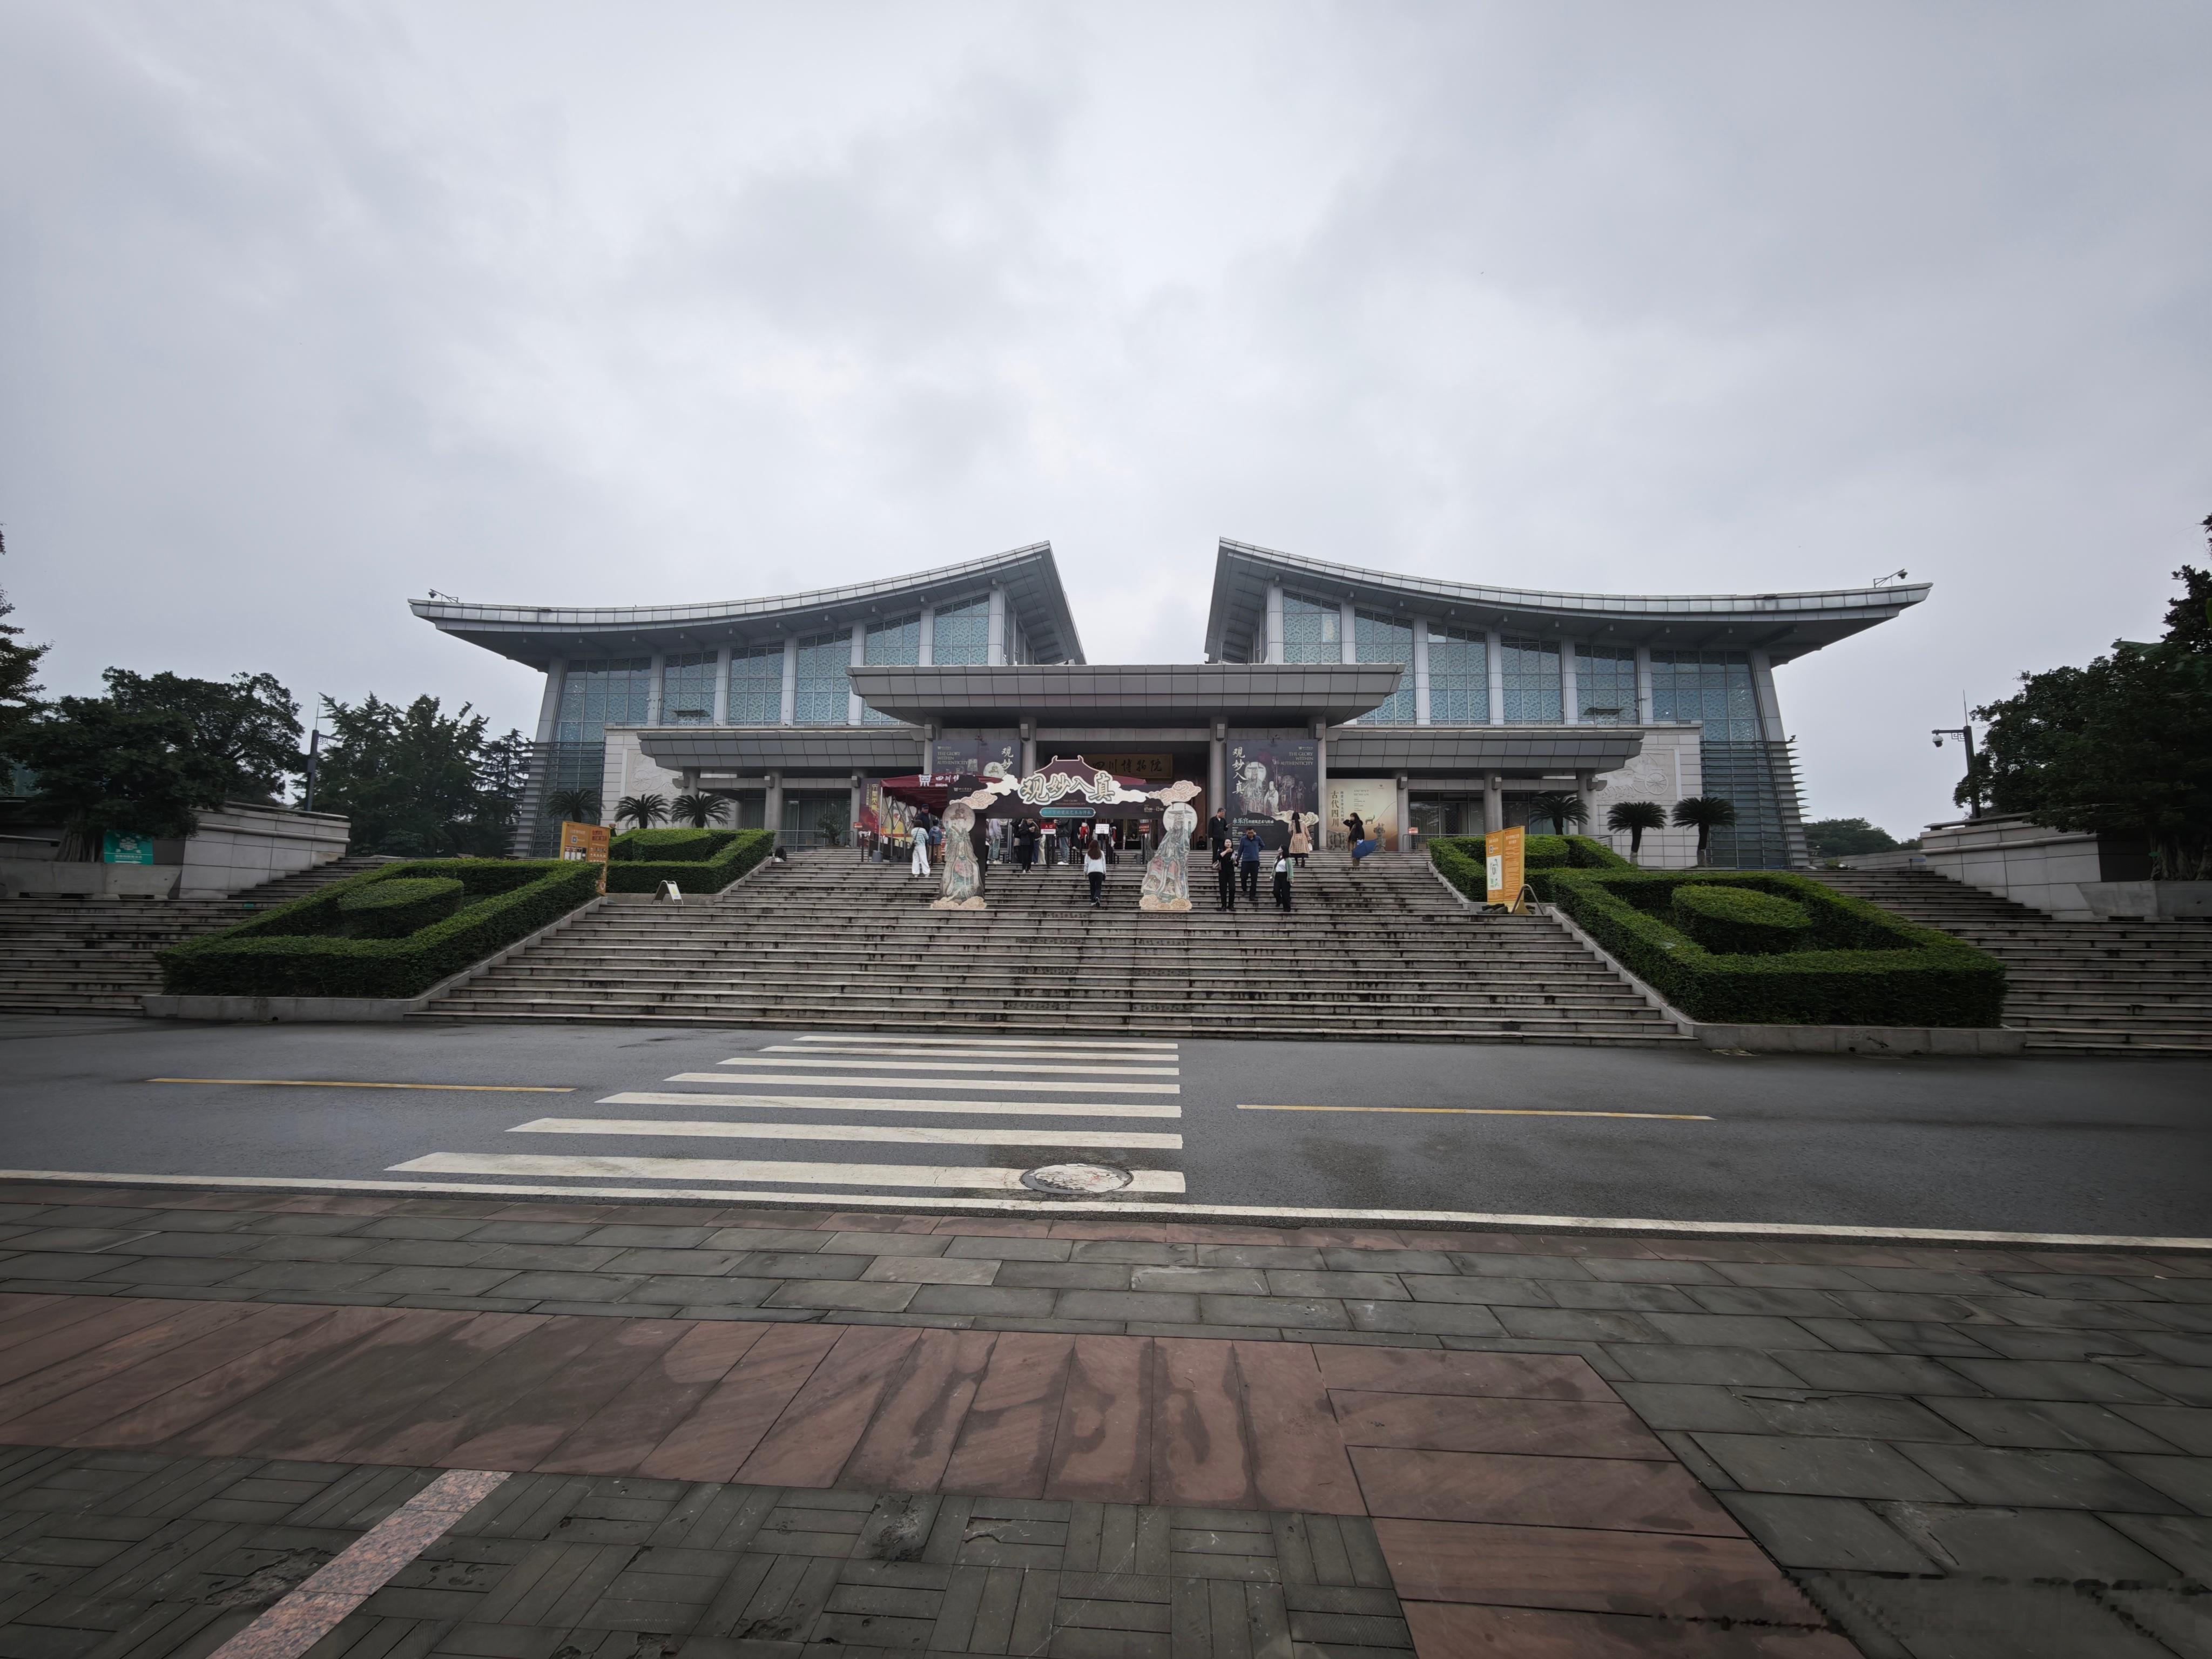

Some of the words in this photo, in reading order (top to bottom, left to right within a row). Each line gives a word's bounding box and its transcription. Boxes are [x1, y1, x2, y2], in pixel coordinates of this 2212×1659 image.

[1092, 758, 1162, 773] 四川博物院
[1232, 746, 1248, 794] 观妙入真
[1020, 773, 1115, 802] 观妙入真
[1331, 791, 1339, 827] 古代四川
